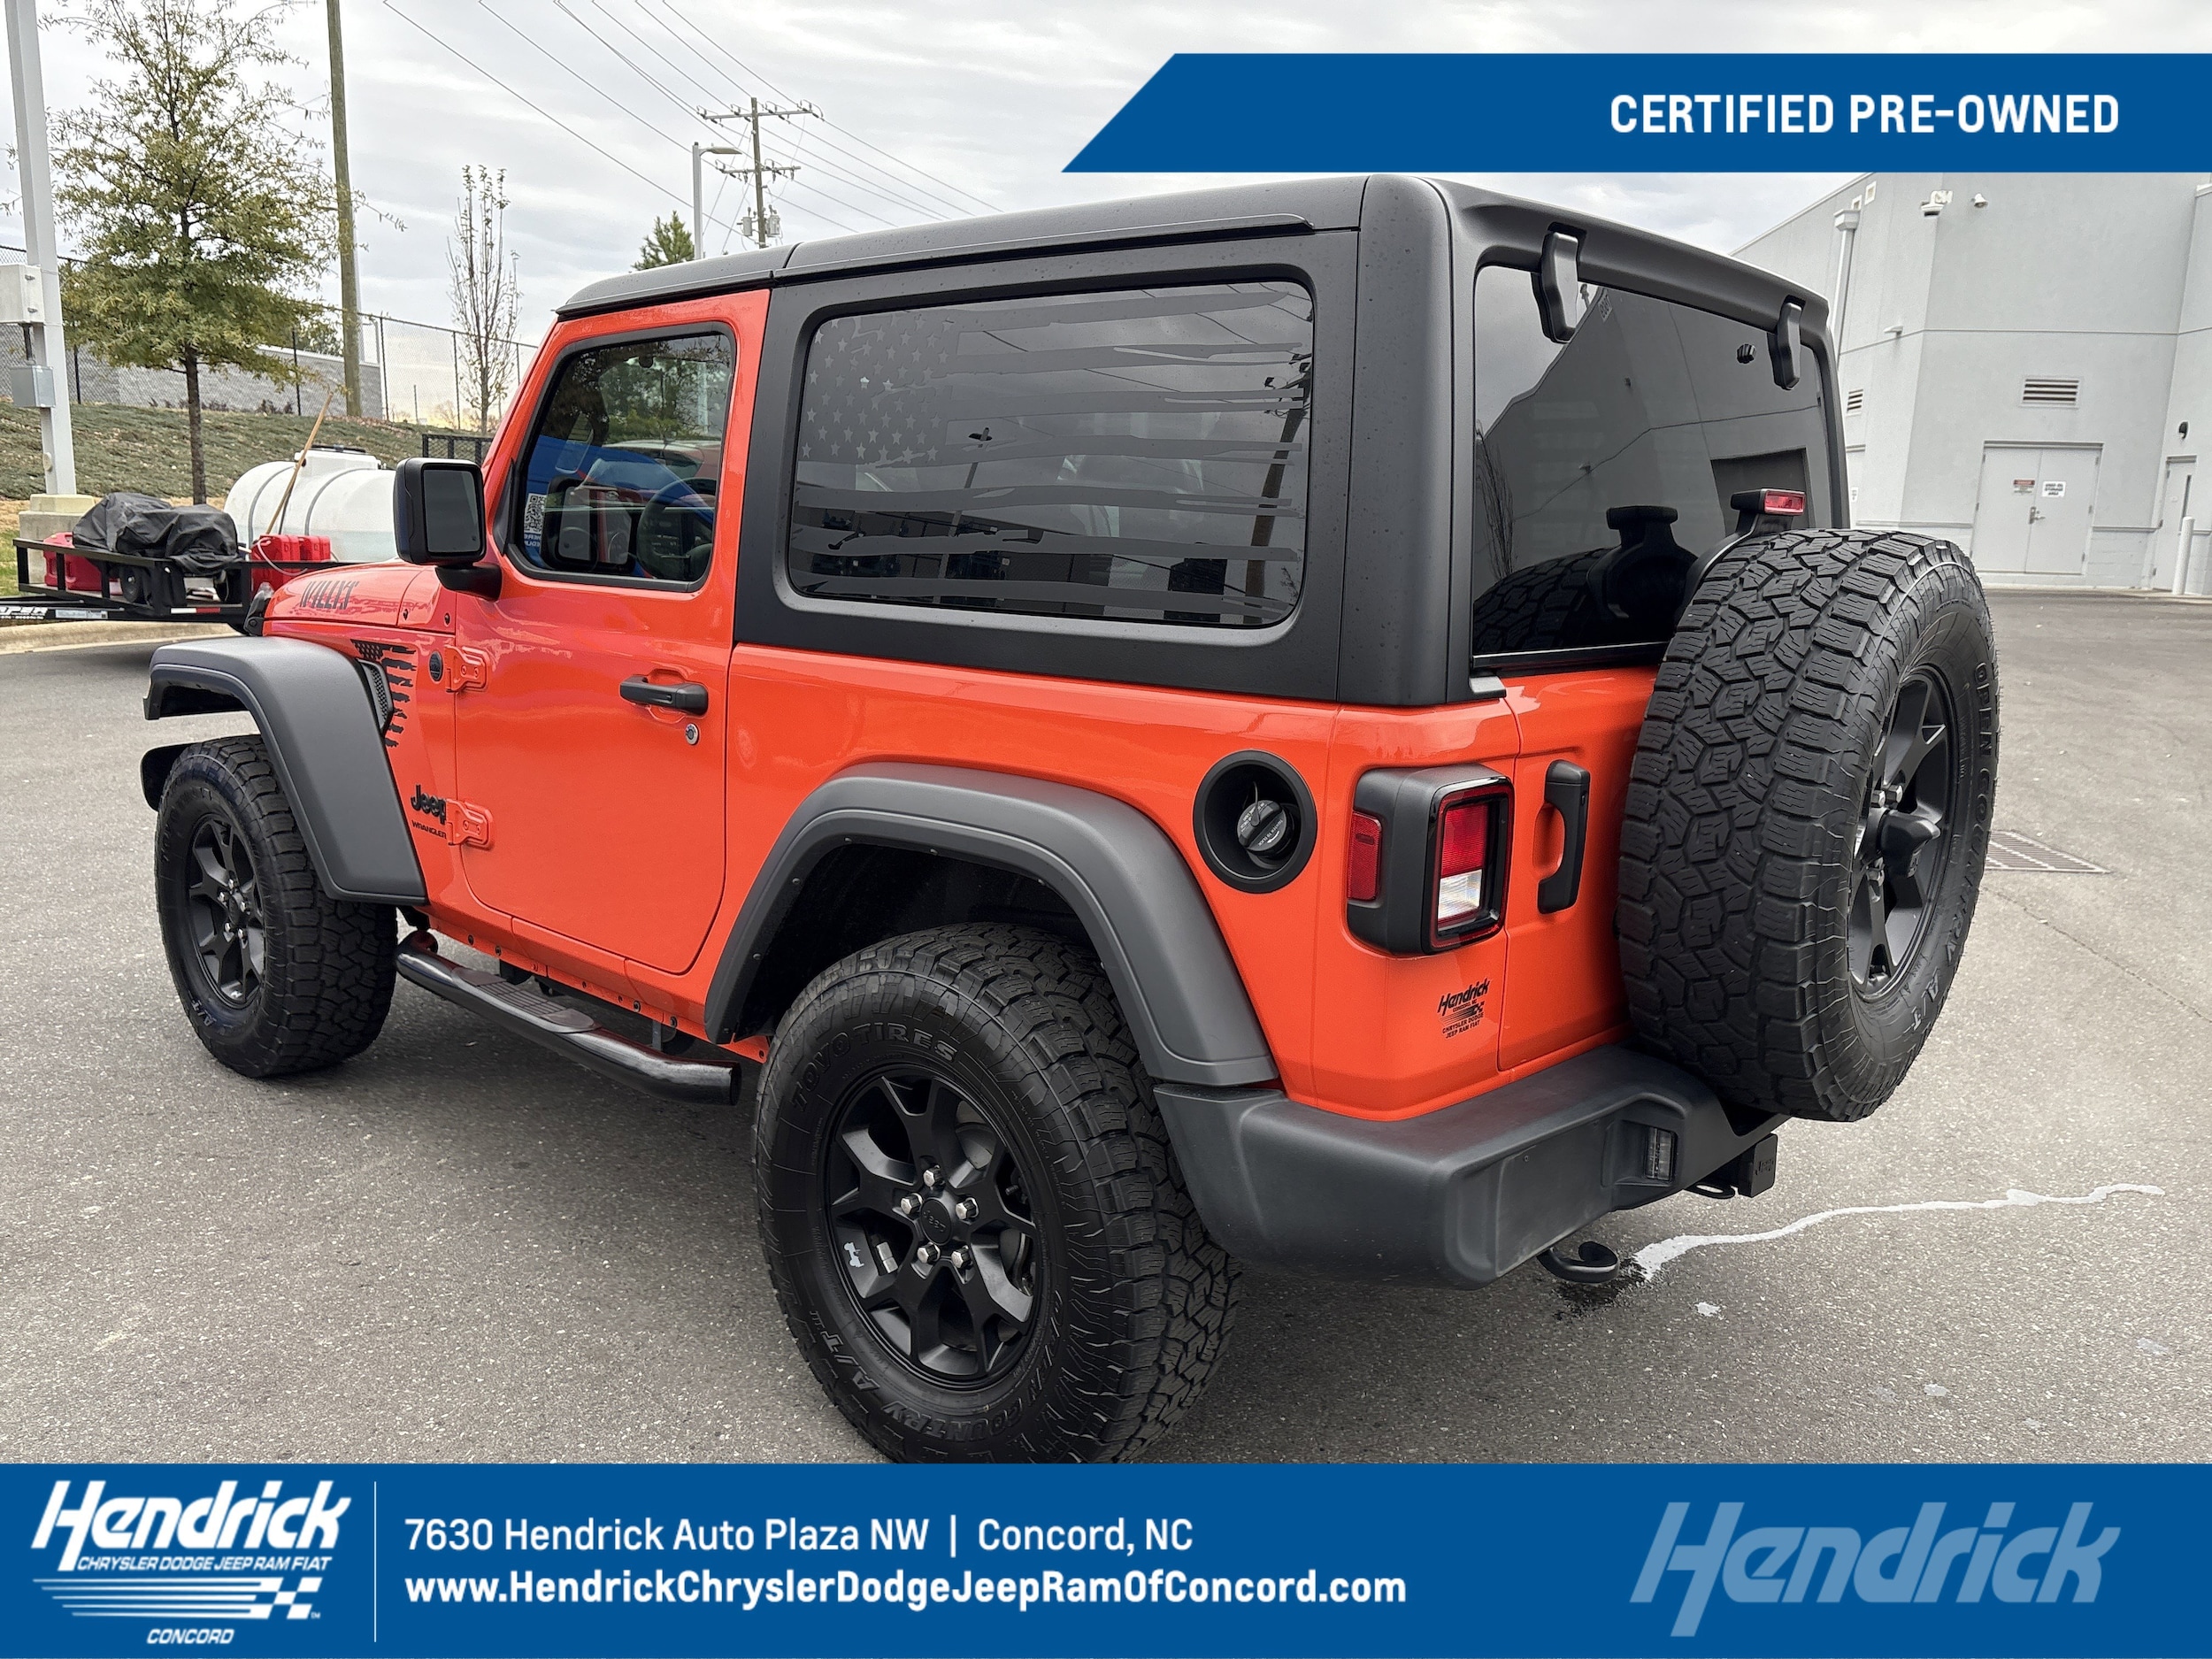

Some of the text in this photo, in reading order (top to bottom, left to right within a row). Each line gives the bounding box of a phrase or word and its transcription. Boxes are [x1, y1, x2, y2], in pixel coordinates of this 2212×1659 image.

[1974, 661, 1993, 758] OPEN
[1437, 977, 1491, 1017] Hendrick
[1442, 1012, 1485, 1034] CHRYSLER DODGE
[1910, 965, 1940, 1031] A/T
[1446, 1019, 1480, 1039] JEEP RAM FIAT
[791, 1032, 851, 1112] TOYO
[853, 1021, 958, 1063] TIRES
[819, 1330, 881, 1391] A/T
[882, 1395, 1024, 1443] COUNTRY
